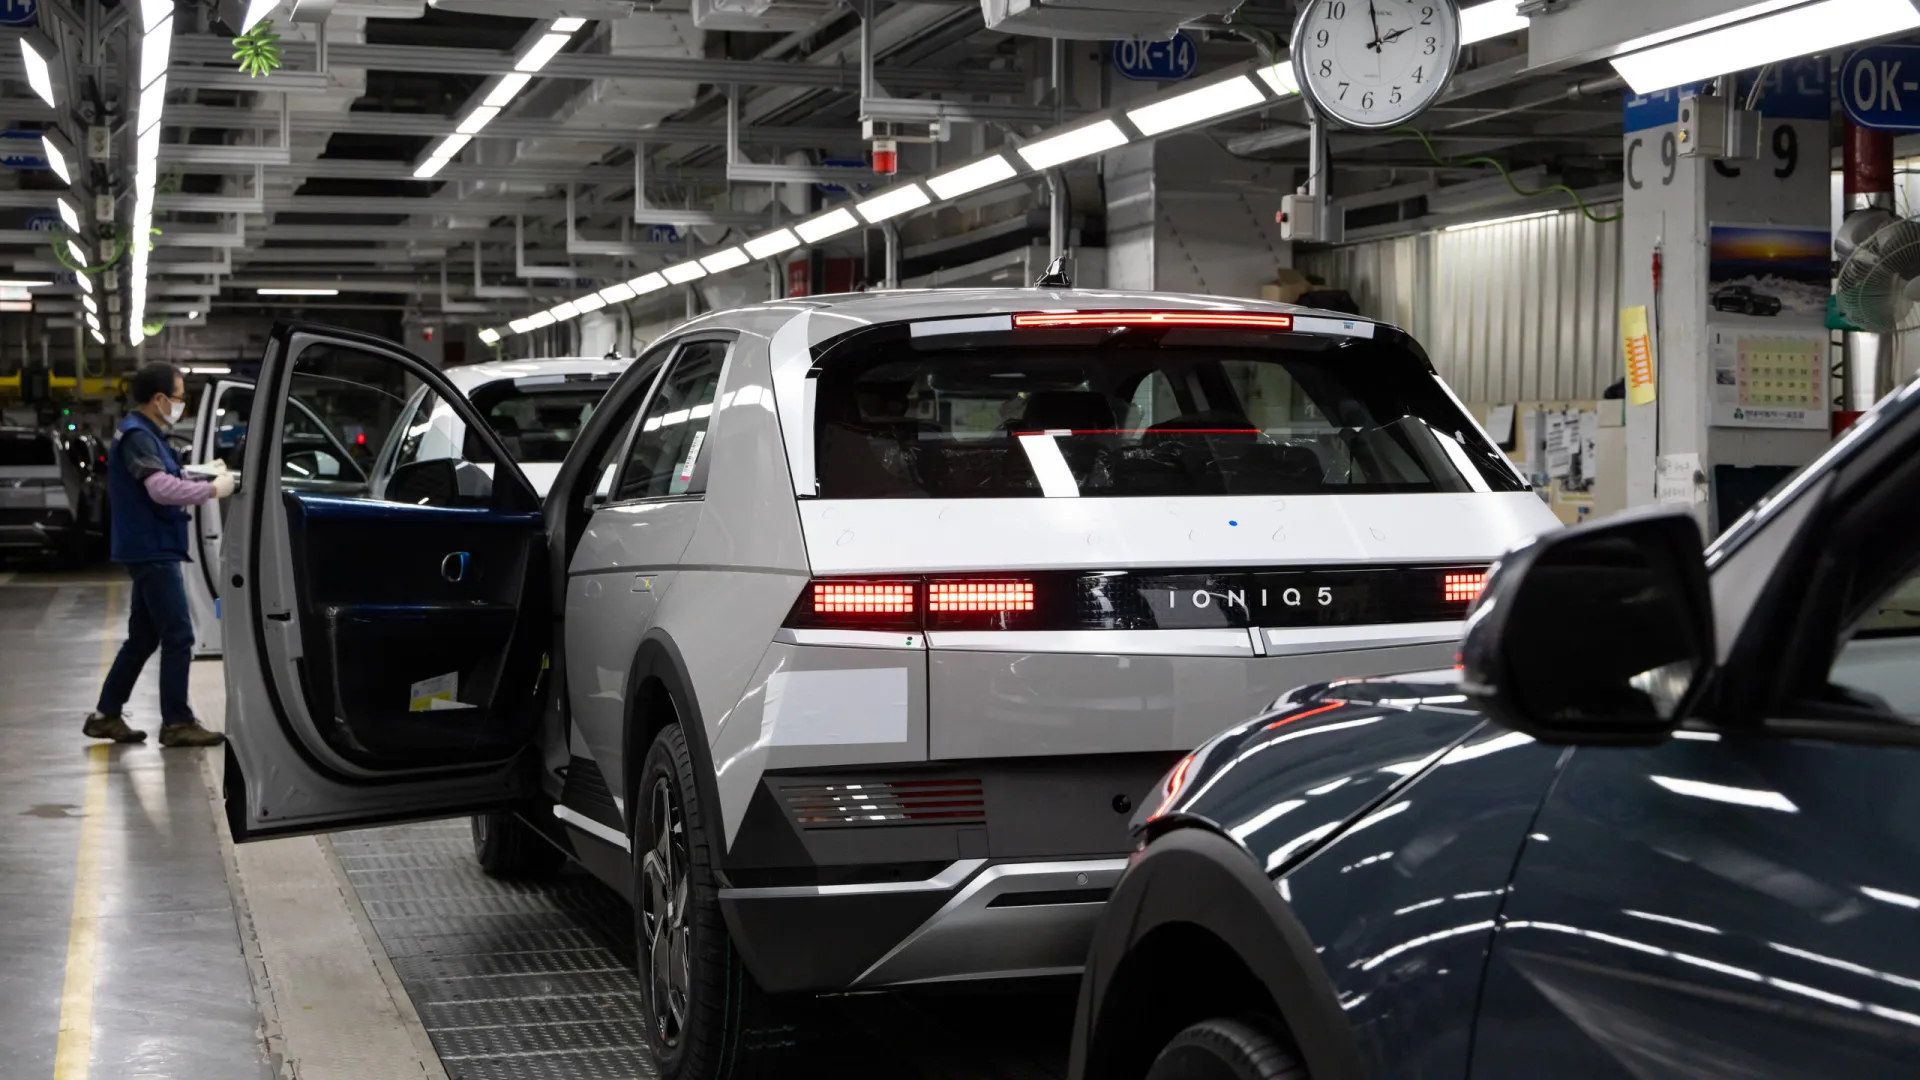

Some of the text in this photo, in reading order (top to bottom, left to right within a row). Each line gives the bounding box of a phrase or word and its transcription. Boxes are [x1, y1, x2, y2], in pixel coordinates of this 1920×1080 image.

[1326, 1, 1346, 20] 10
[1420, 6, 1433, 26] 2
[1316, 29, 1329, 48] 9
[1423, 37, 1436, 55] 3
[1121, 40, 1189, 72] OK-14
[1319, 59, 1332, 78] 8
[1411, 65, 1424, 83] 4
[1338, 82, 1350, 101] 7
[1361, 91, 1374, 110] 6
[1389, 86, 1402, 104] 5
[1627, 131, 1677, 190] C 9
[1772, 124, 1798, 178] 9
